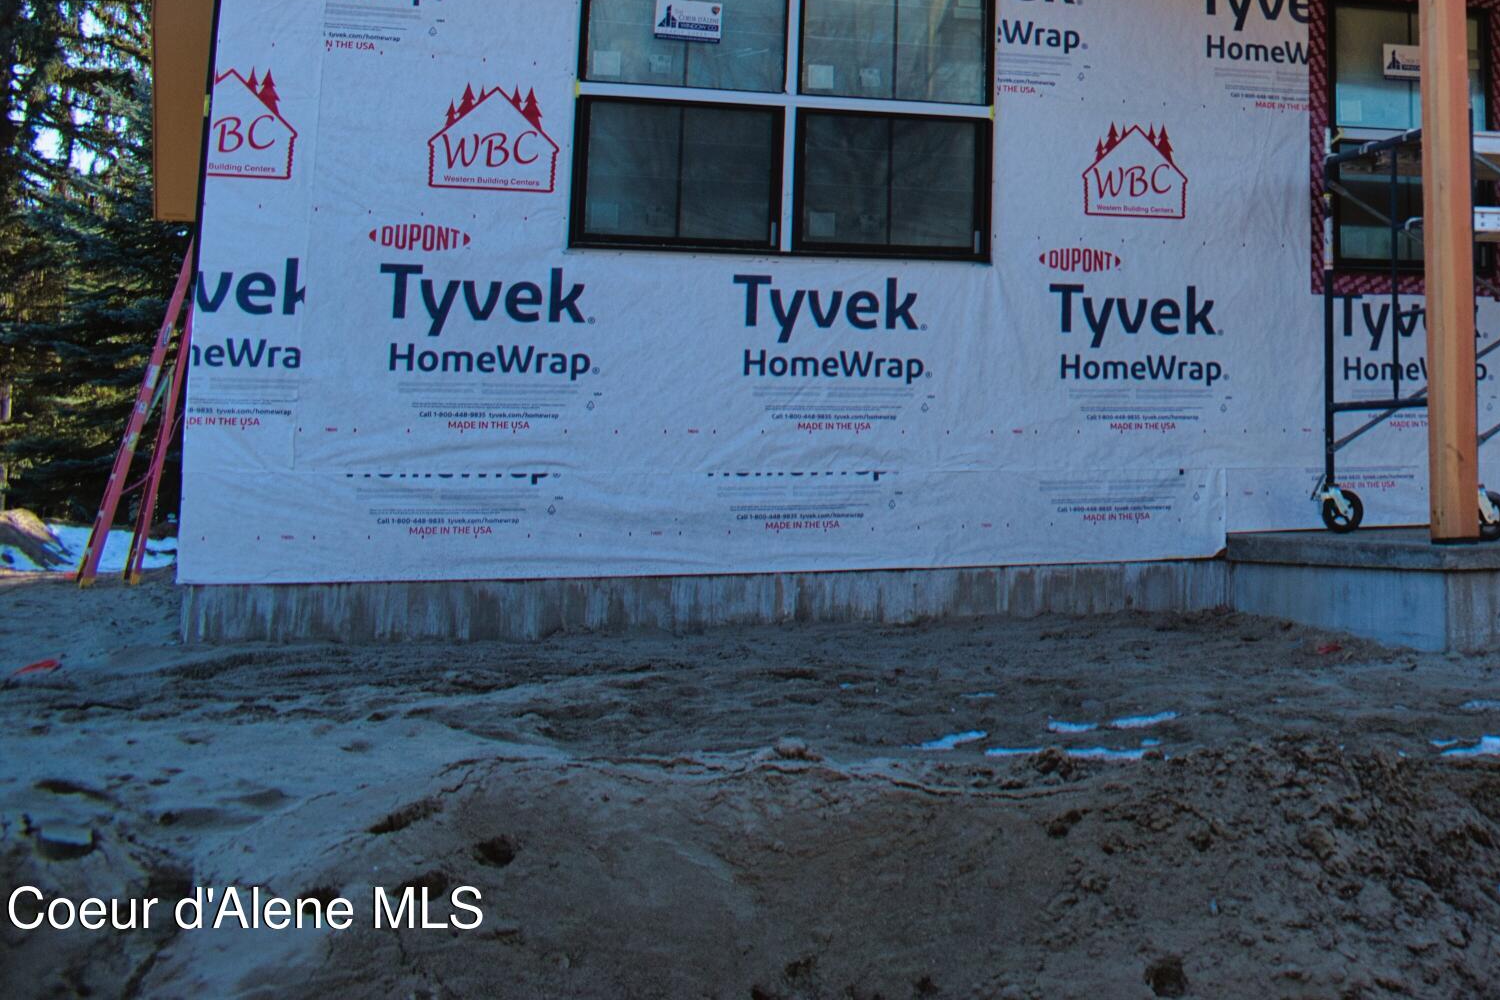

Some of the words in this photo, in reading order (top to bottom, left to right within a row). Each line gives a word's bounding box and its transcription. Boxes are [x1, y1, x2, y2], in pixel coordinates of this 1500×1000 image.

[336, 40, 353, 49] THE
[356, 41, 375, 50] USA
[1003, 85, 1018, 93] THE
[1020, 86, 1035, 94] USA
[213, 115, 275, 153] BC
[442, 131, 539, 169] WBC
[245, 164, 276, 172] Centers
[444, 175, 475, 183] Western
[477, 176, 508, 185] Building
[511, 178, 539, 186] Centers
[1093, 164, 1171, 199] WBC
[381, 224, 460, 251] DUPONT
[1049, 248, 1112, 272] DUPONT
[380, 263, 586, 337] Tyvek
[733, 274, 918, 343] Tyvek
[1049, 284, 1216, 348] Tyvek
[389, 343, 591, 381] HomeWrap
[743, 349, 924, 384] HomeWrap
[1060, 354, 1222, 386] HomeWrap
[205, 417, 215, 425] IN
[219, 417, 236, 425] THE
[240, 417, 260, 426] USA
[448, 421, 476, 429] MADE
[479, 421, 488, 429] IN
[491, 421, 509, 429] THE
[511, 422, 530, 430] USA
[798, 422, 823, 430] MADE
[825, 422, 834, 430] IN
[837, 422, 853, 430] THE
[855, 422, 871, 431] USA
[765, 521, 791, 529] MADE
[794, 521, 802, 529] IN
[804, 521, 820, 529] THE
[822, 520, 840, 529] USA
[1083, 513, 1106, 521] MADE
[1135, 512, 1150, 520] USA
[409, 526, 437, 535] MADE
[440, 526, 450, 534] IN
[452, 526, 471, 534] THE
[474, 526, 492, 534] USA
